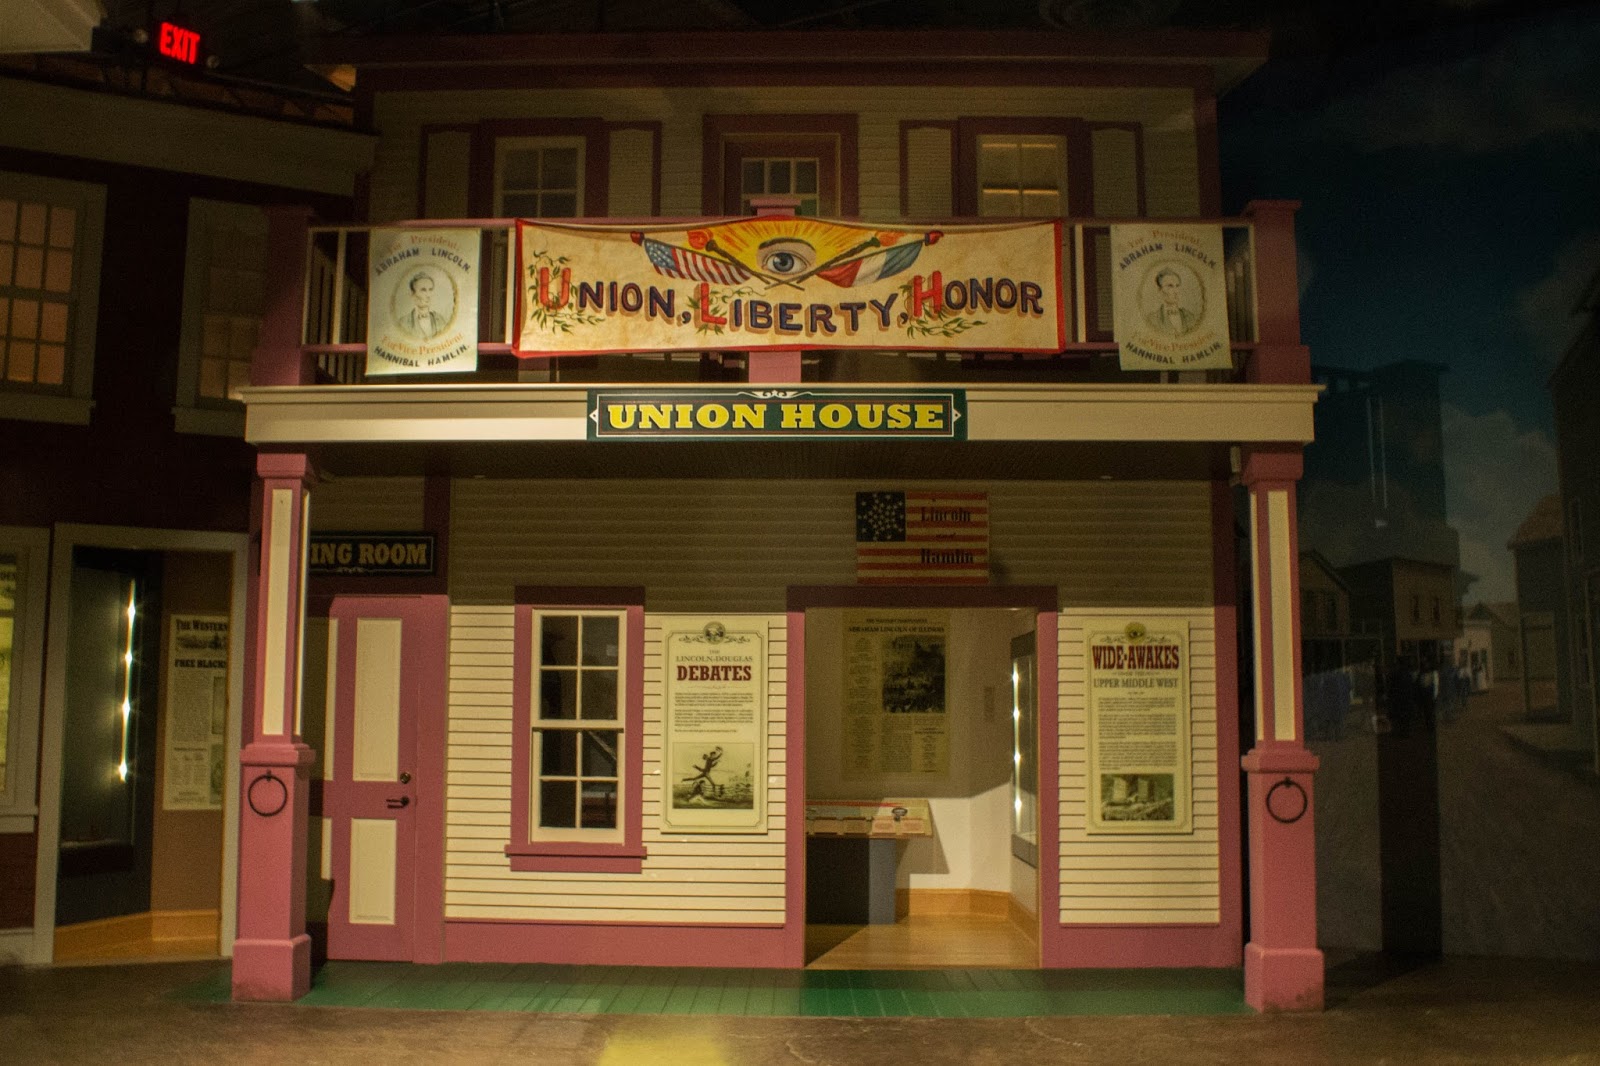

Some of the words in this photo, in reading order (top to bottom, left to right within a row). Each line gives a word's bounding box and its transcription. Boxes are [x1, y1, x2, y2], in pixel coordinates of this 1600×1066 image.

[160, 22, 200, 64] EXIT
[375, 248, 419, 276] ABRAHAM
[1119, 243, 1163, 270] ABRAHAM
[540, 267, 692, 324] UNION,
[700, 282, 909, 333] LIBERTY,
[912, 270, 1044, 317] HONOR
[374, 346, 420, 367] HANNIBAL
[1125, 342, 1175, 364] HANNIBAL
[607, 404, 767, 429] UNION
[781, 404, 944, 429] HOUSE
[311, 543, 352, 565] ING
[358, 543, 428, 565] ROOM
[176, 619, 191, 630] THE
[175, 659, 196, 668] FREE
[1092, 645, 1179, 669] WIDE-AWAKES
[676, 665, 752, 681] DEBATES
[1093, 678, 1120, 688] UPPER
[1122, 678, 1154, 688] MIDDLE
[1156, 678, 1178, 688] WEST
